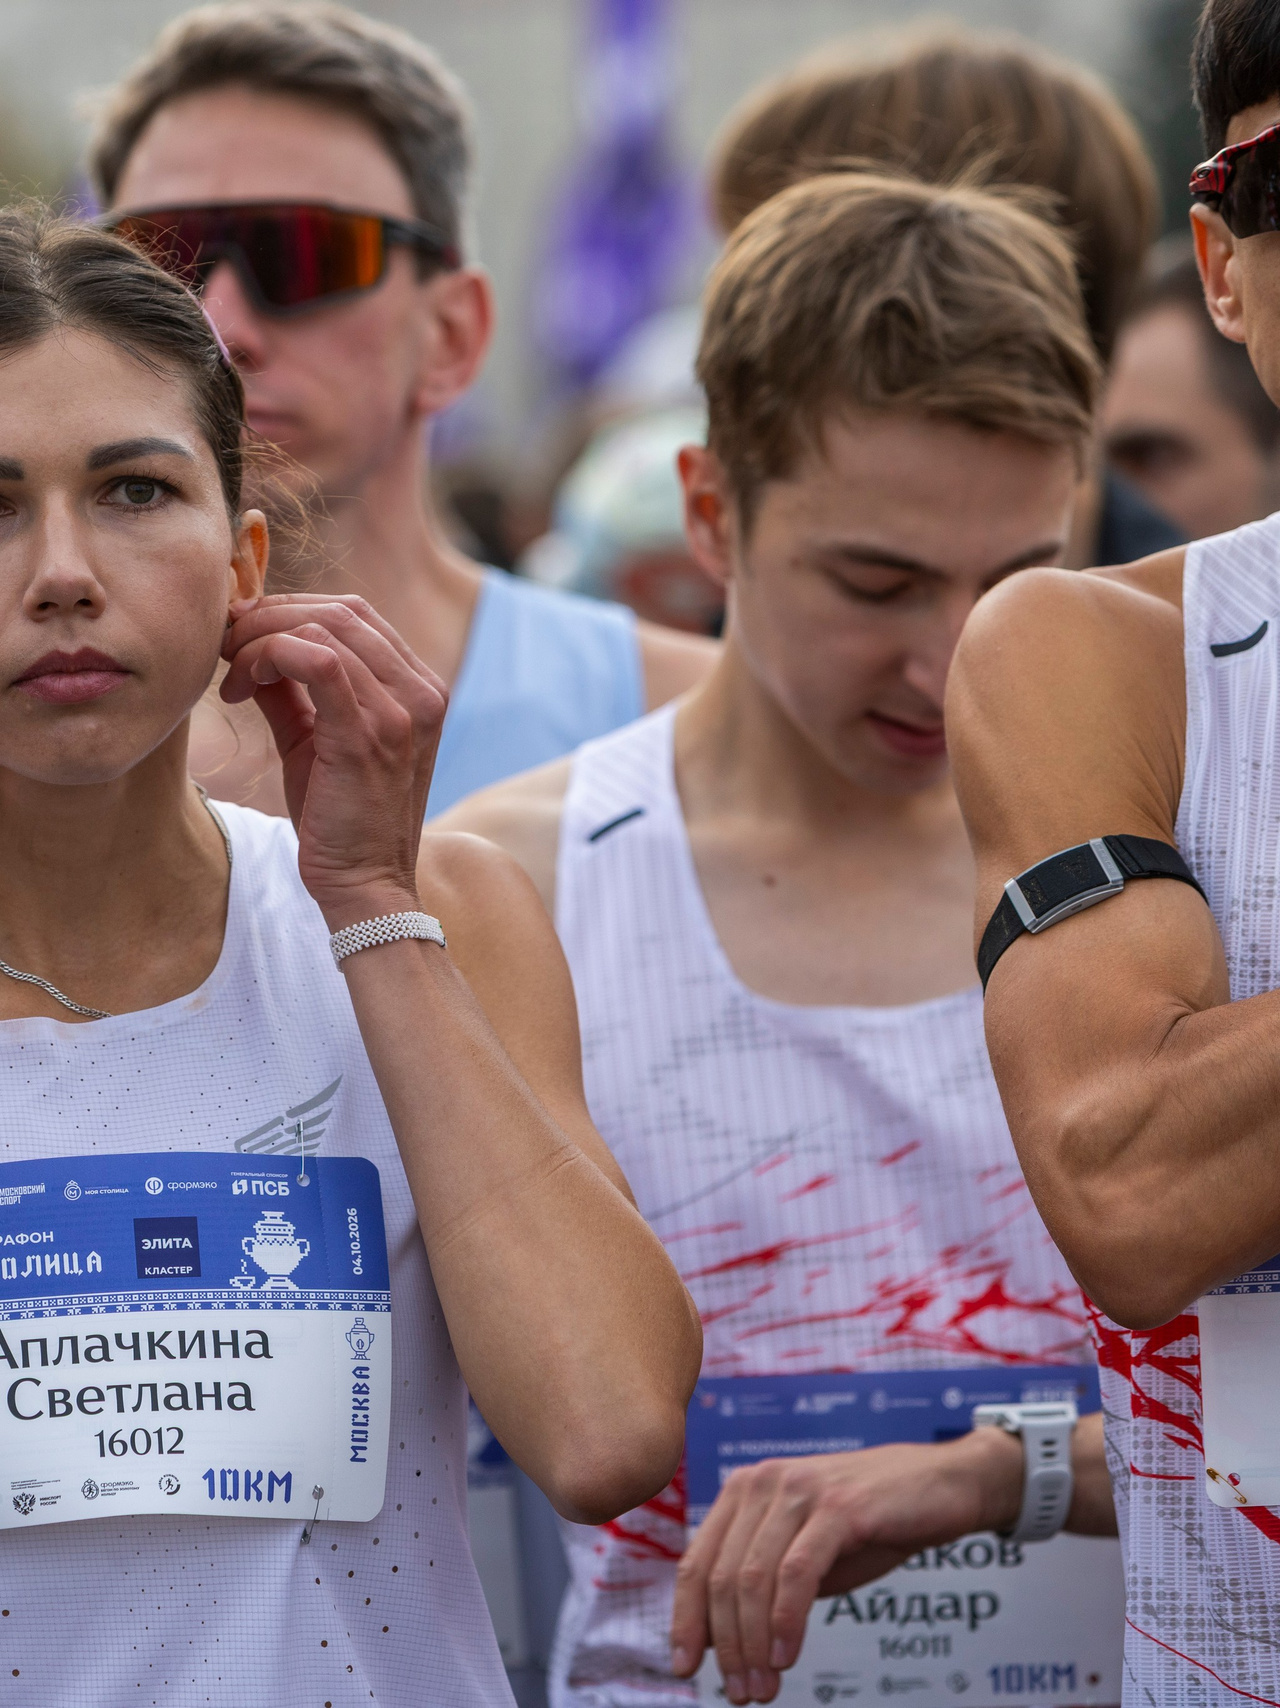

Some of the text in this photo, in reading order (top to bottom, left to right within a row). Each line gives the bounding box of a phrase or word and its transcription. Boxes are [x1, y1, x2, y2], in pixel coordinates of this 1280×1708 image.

[167, 1181, 217, 1191] фармэко
[251, 1180, 290, 1196] ПСБ
[0, 1196, 21, 1206] СПОРТ
[141, 1237, 193, 1251] ЭЛИТА
[347, 1207, 363, 1275] 04.10.2026
[144, 1264, 193, 1275] КЛАСТЕР
[6, 1377, 255, 1420] Светлана
[350, 1366, 370, 1463] МОСКВА
[94, 1427, 185, 1458] 16012
[824, 1587, 1000, 1632] Айдар
[878, 1634, 952, 1660] 16011
